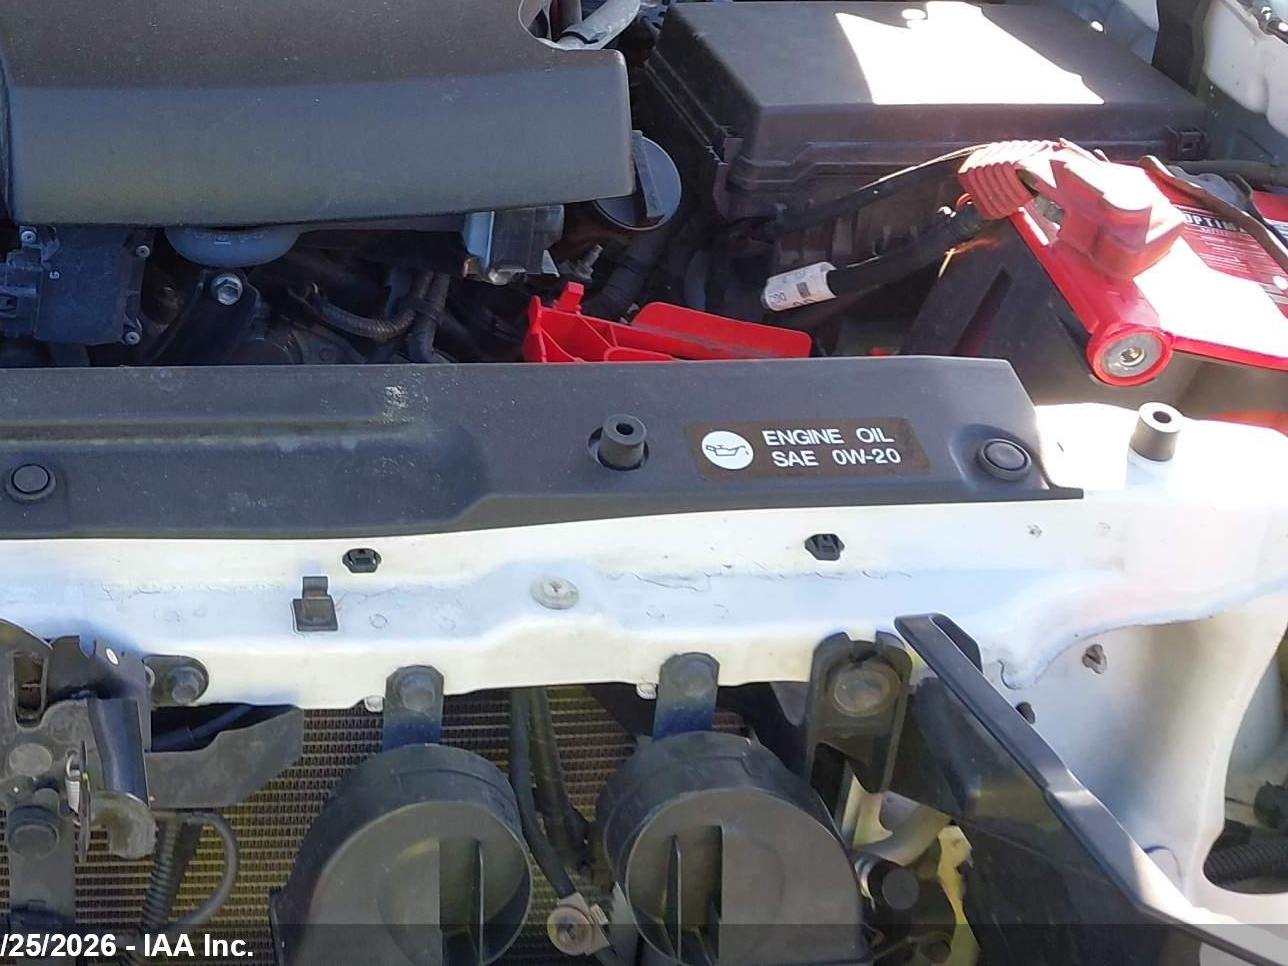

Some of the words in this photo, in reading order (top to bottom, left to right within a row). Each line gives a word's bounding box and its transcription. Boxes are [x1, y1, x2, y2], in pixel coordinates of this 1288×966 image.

[762, 428, 845, 446] ENGINE
[855, 427, 895, 443] OIL
[771, 450, 819, 467] SAE
[831, 448, 901, 466] 0W-20
